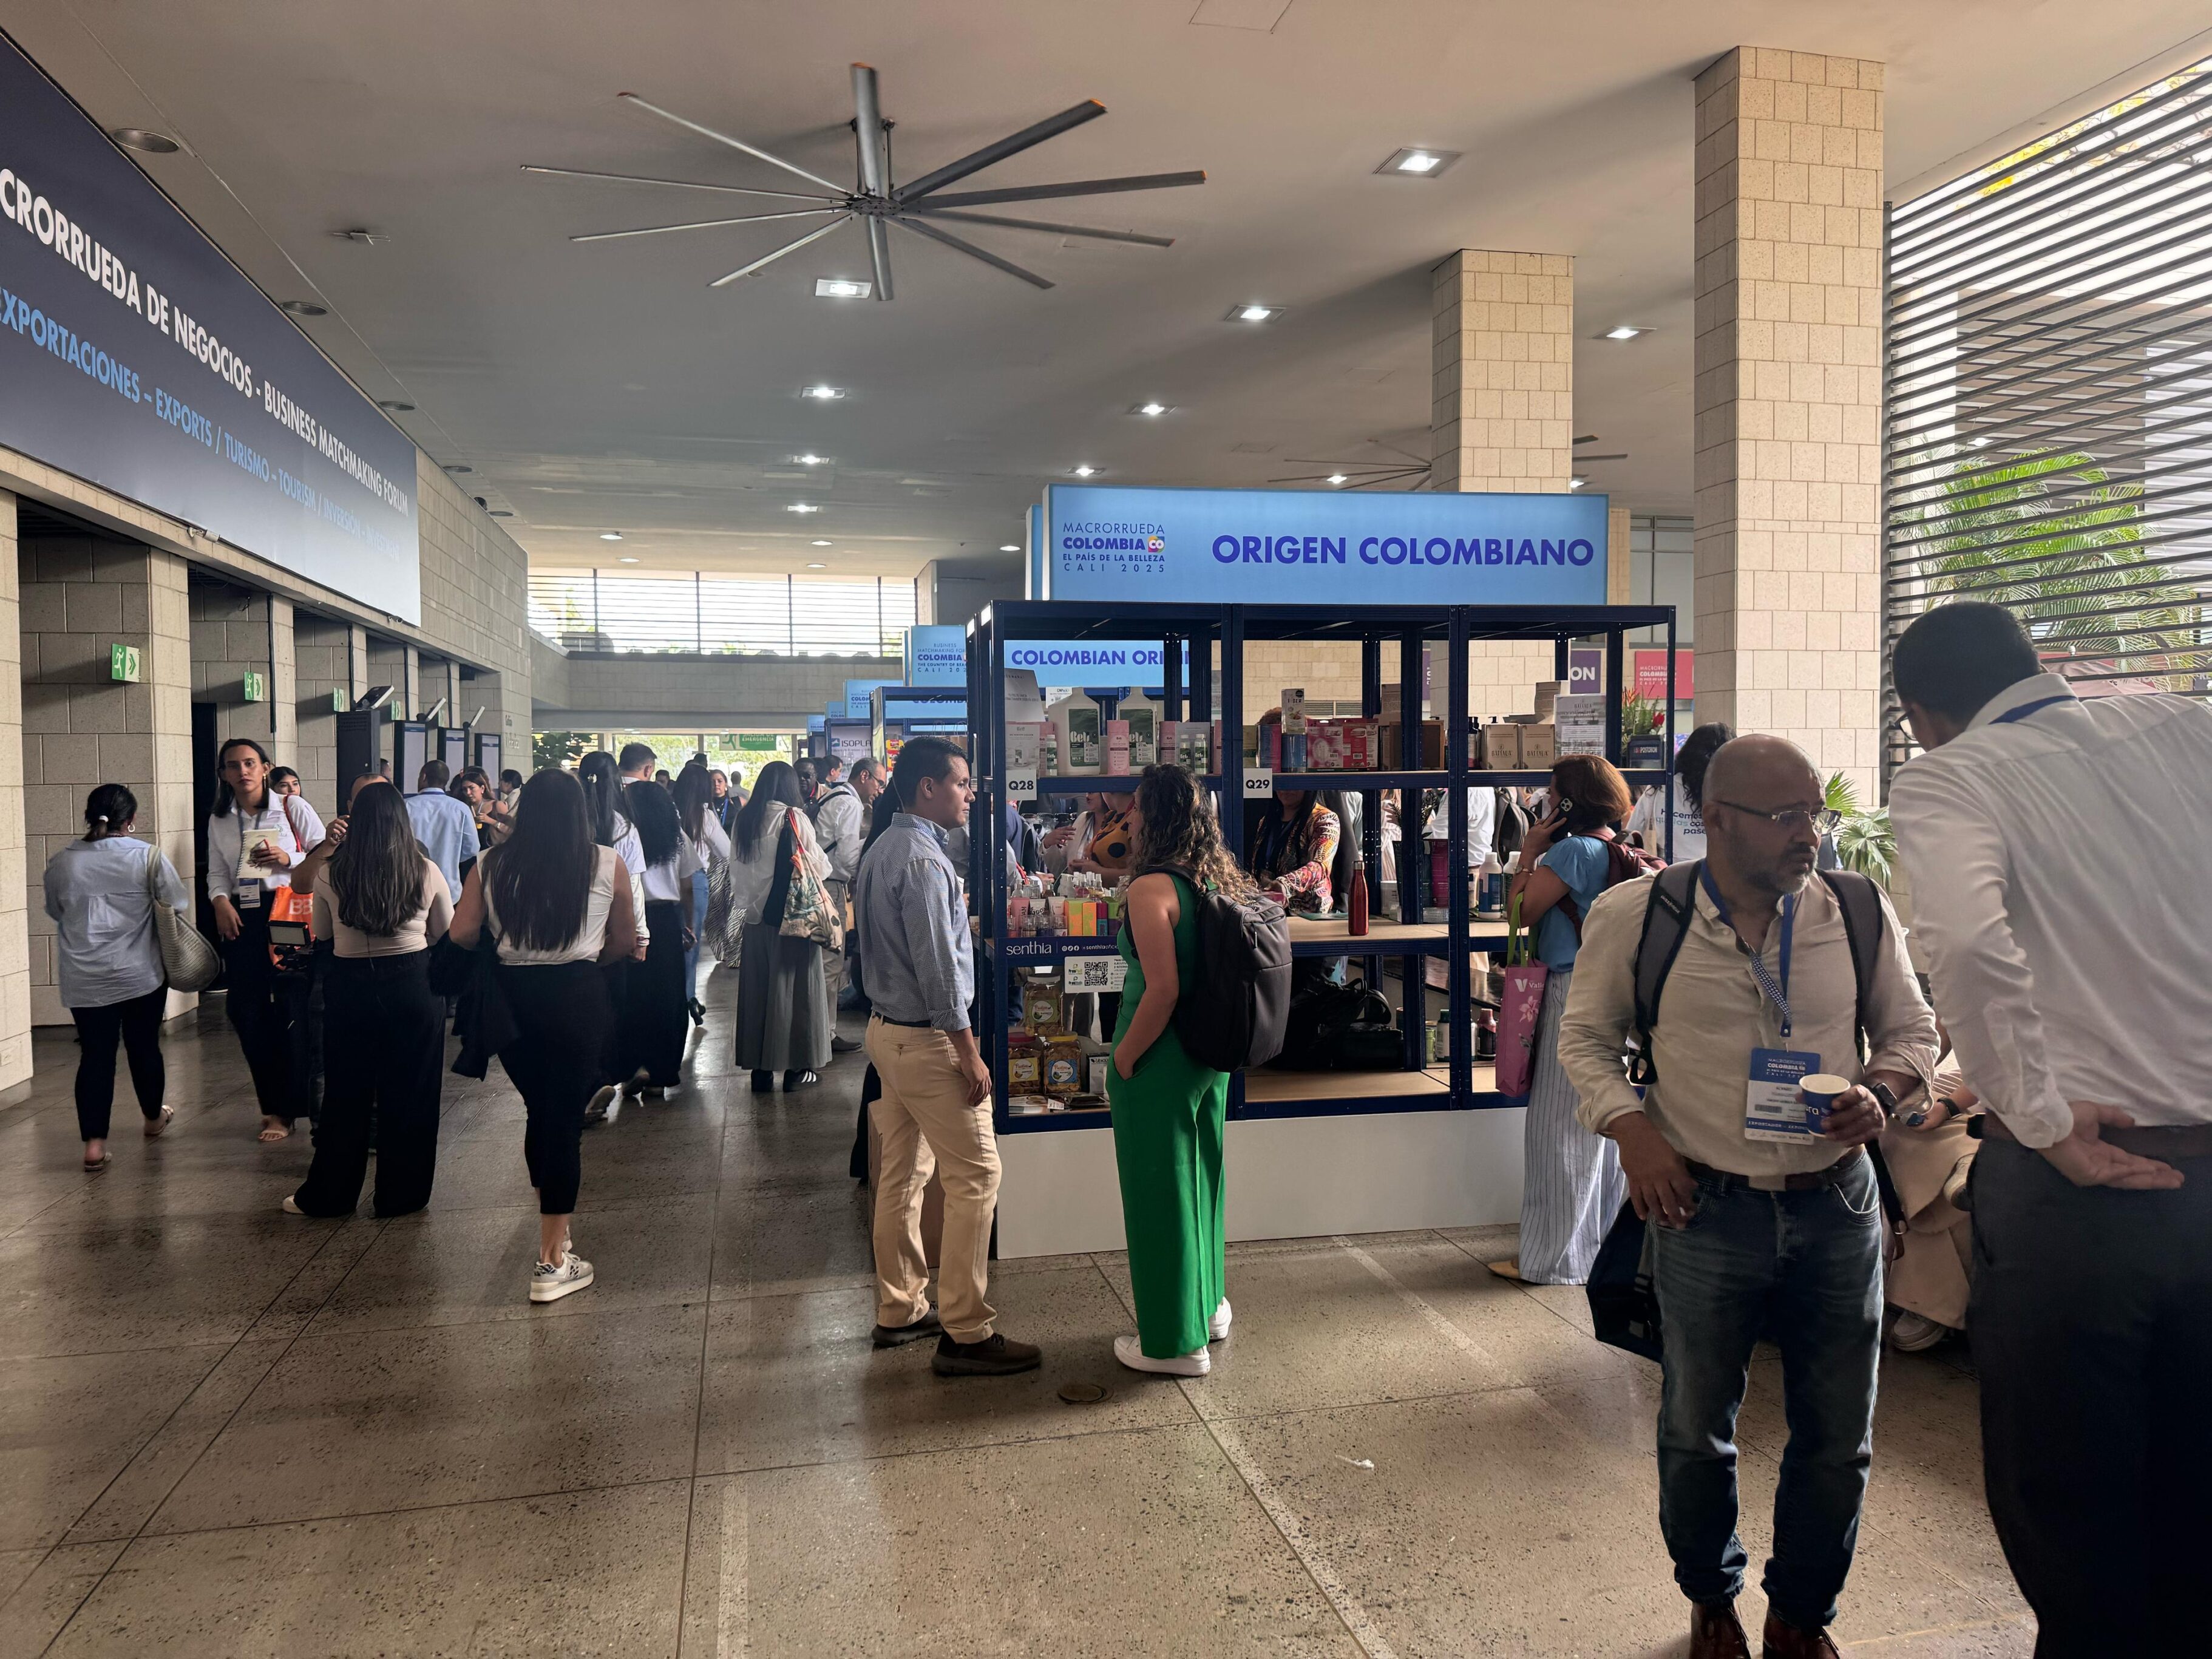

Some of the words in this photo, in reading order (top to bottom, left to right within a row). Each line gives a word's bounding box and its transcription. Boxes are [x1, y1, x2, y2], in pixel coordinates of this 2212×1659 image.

[147, 283, 169, 335] DE
[174, 306, 252, 398] NEGOCIOS
[264, 380, 316, 447] BUSINESS
[319, 426, 382, 497] MATCHMAKING
[384, 478, 409, 517] FORUM
[156, 387, 212, 447] EXPORTS
[225, 432, 269, 483] TURISMO
[278, 467, 316, 512] TOURISM
[1063, 522, 1165, 534] MACRORRUEDA
[1063, 537, 1146, 550] COLOMBIA
[1076, 552, 1095, 561] PAÍS
[1212, 535, 1346, 564] ORIGEN
[1359, 537, 1594, 566] COLOMBIANO
[1064, 563, 1104, 572] CALI
[1121, 564, 1164, 572] 2025
[1011, 650, 1125, 665] COLOMBIAN
[1009, 780, 1034, 790] Q28
[1246, 779, 1269, 792] Q29
[1661, 809, 1702, 819] Hcemos
[1006, 941, 1052, 955] senthia
